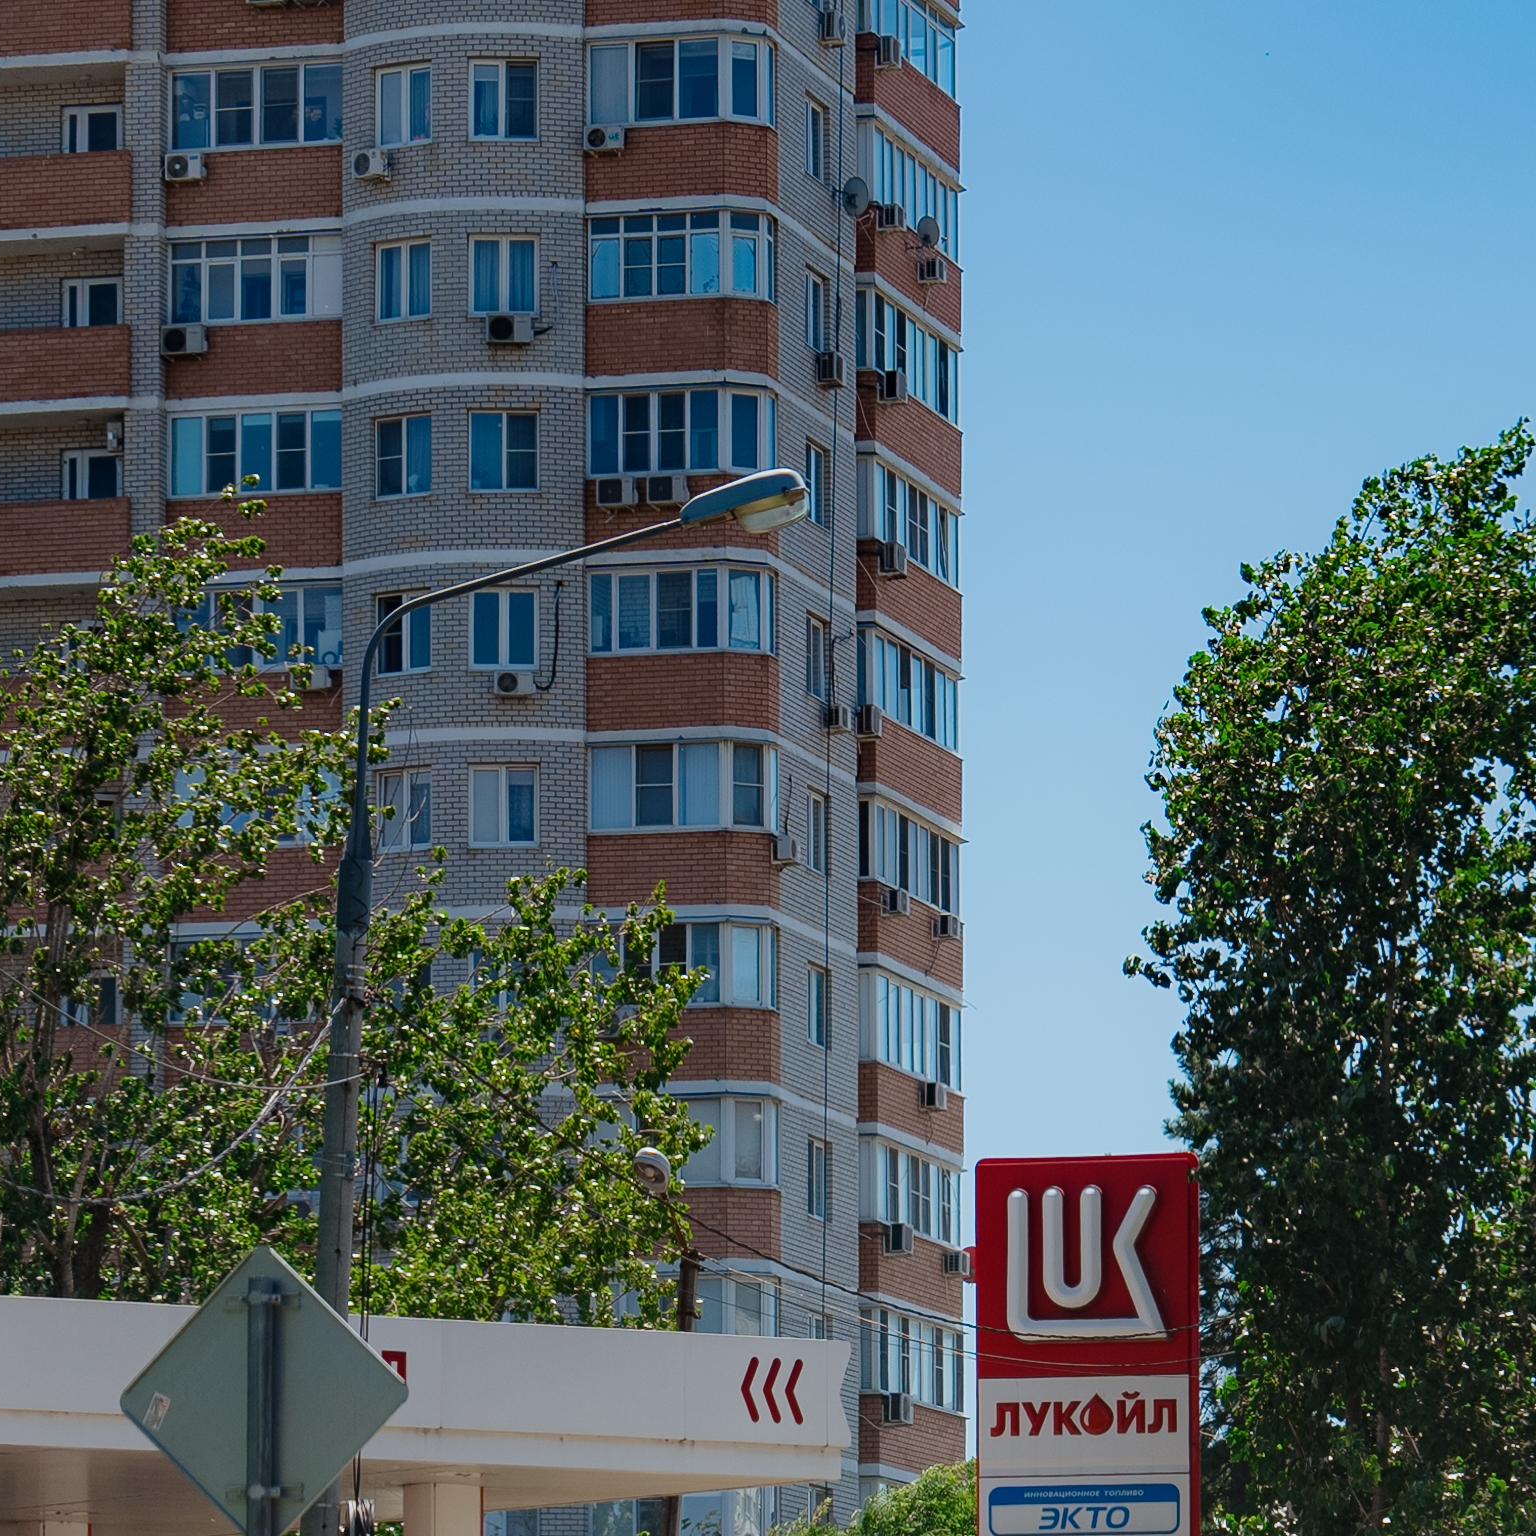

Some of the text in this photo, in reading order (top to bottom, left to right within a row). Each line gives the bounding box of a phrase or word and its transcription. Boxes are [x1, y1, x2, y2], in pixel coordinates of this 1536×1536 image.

[990, 1391, 1178, 1437] ЛУКОЙЛ
[1024, 1489, 1144, 1498] ИННОВАЦИОННОЕ ТОПЛИВО
[1039, 1506, 1130, 1530] ЭКТО
